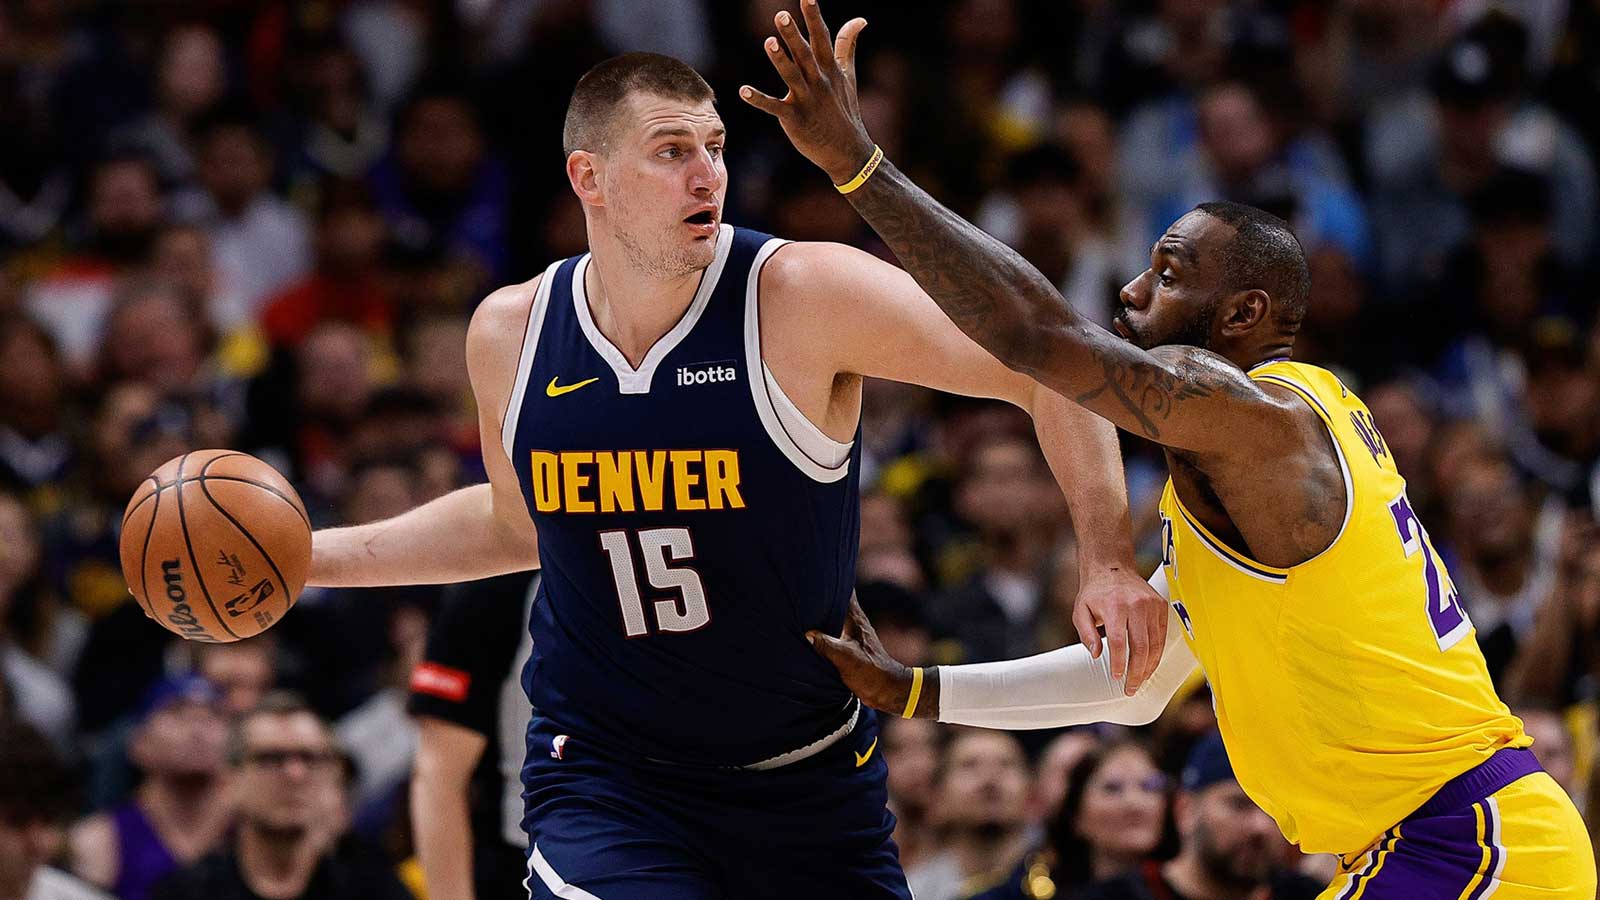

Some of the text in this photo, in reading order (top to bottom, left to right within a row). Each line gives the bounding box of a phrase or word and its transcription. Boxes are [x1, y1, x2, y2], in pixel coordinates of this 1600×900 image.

[677, 367, 736, 386] ibotta
[530, 449, 746, 513] DENVER
[599, 527, 711, 637] 15
